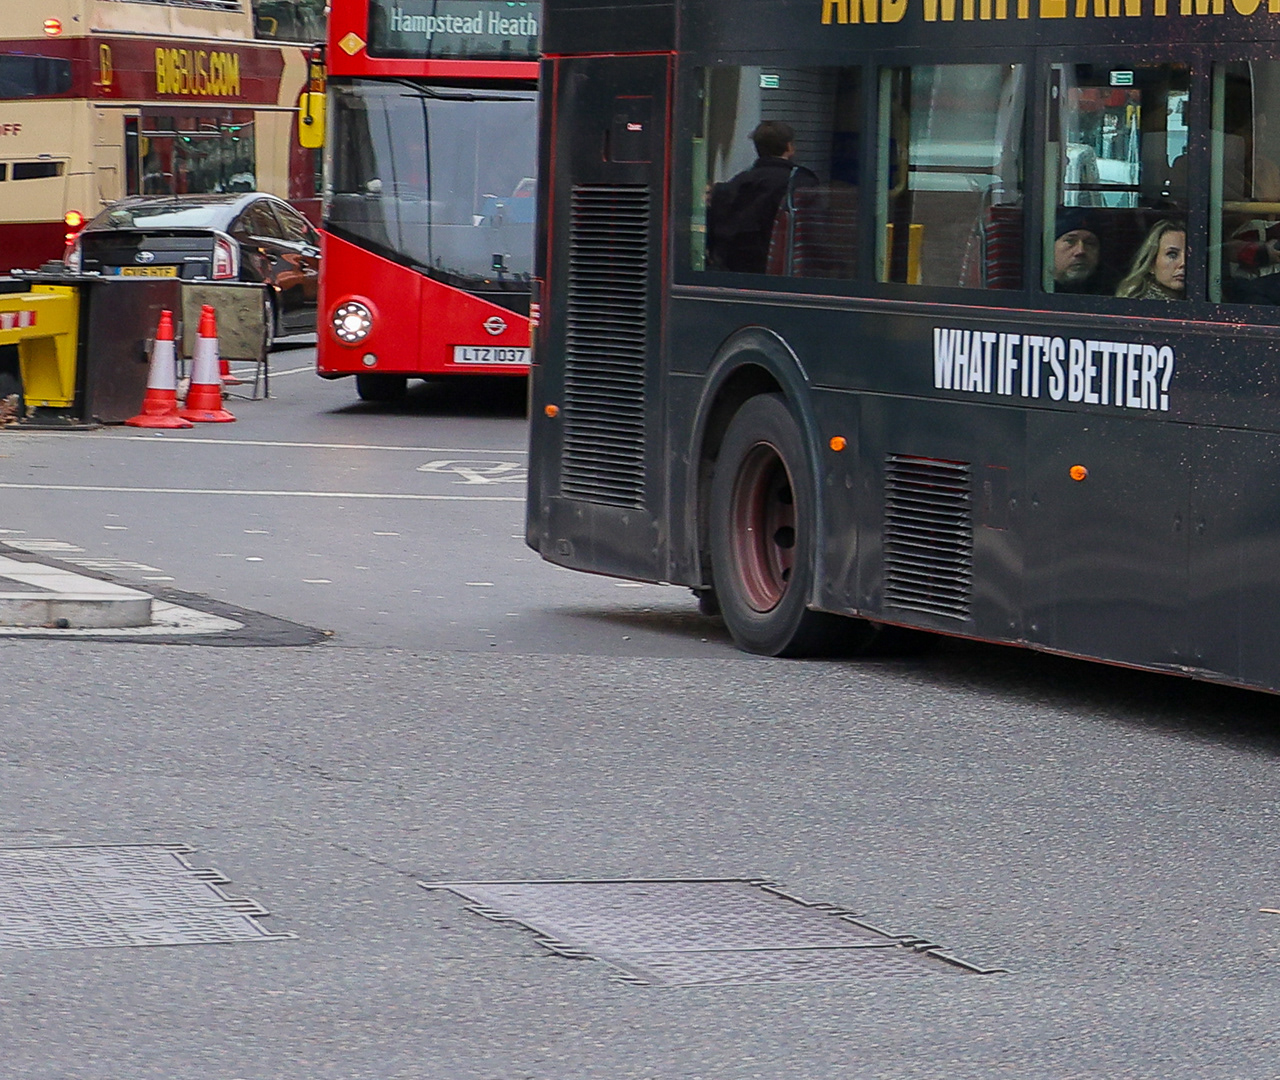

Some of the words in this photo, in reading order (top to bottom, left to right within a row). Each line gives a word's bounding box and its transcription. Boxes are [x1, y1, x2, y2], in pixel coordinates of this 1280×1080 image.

[391, 6, 483, 40] Hampstead
[488, 11, 538, 36] Heath
[155, 47, 241, 96] BIGBUS.COM
[463, 348, 490, 362] LTZ
[494, 349, 525, 362] 1037
[933, 327, 998, 394] WHAT
[997, 332, 1021, 396] IF
[1020, 334, 1067, 402] IT'S
[1067, 338, 1175, 412] BETTER?
